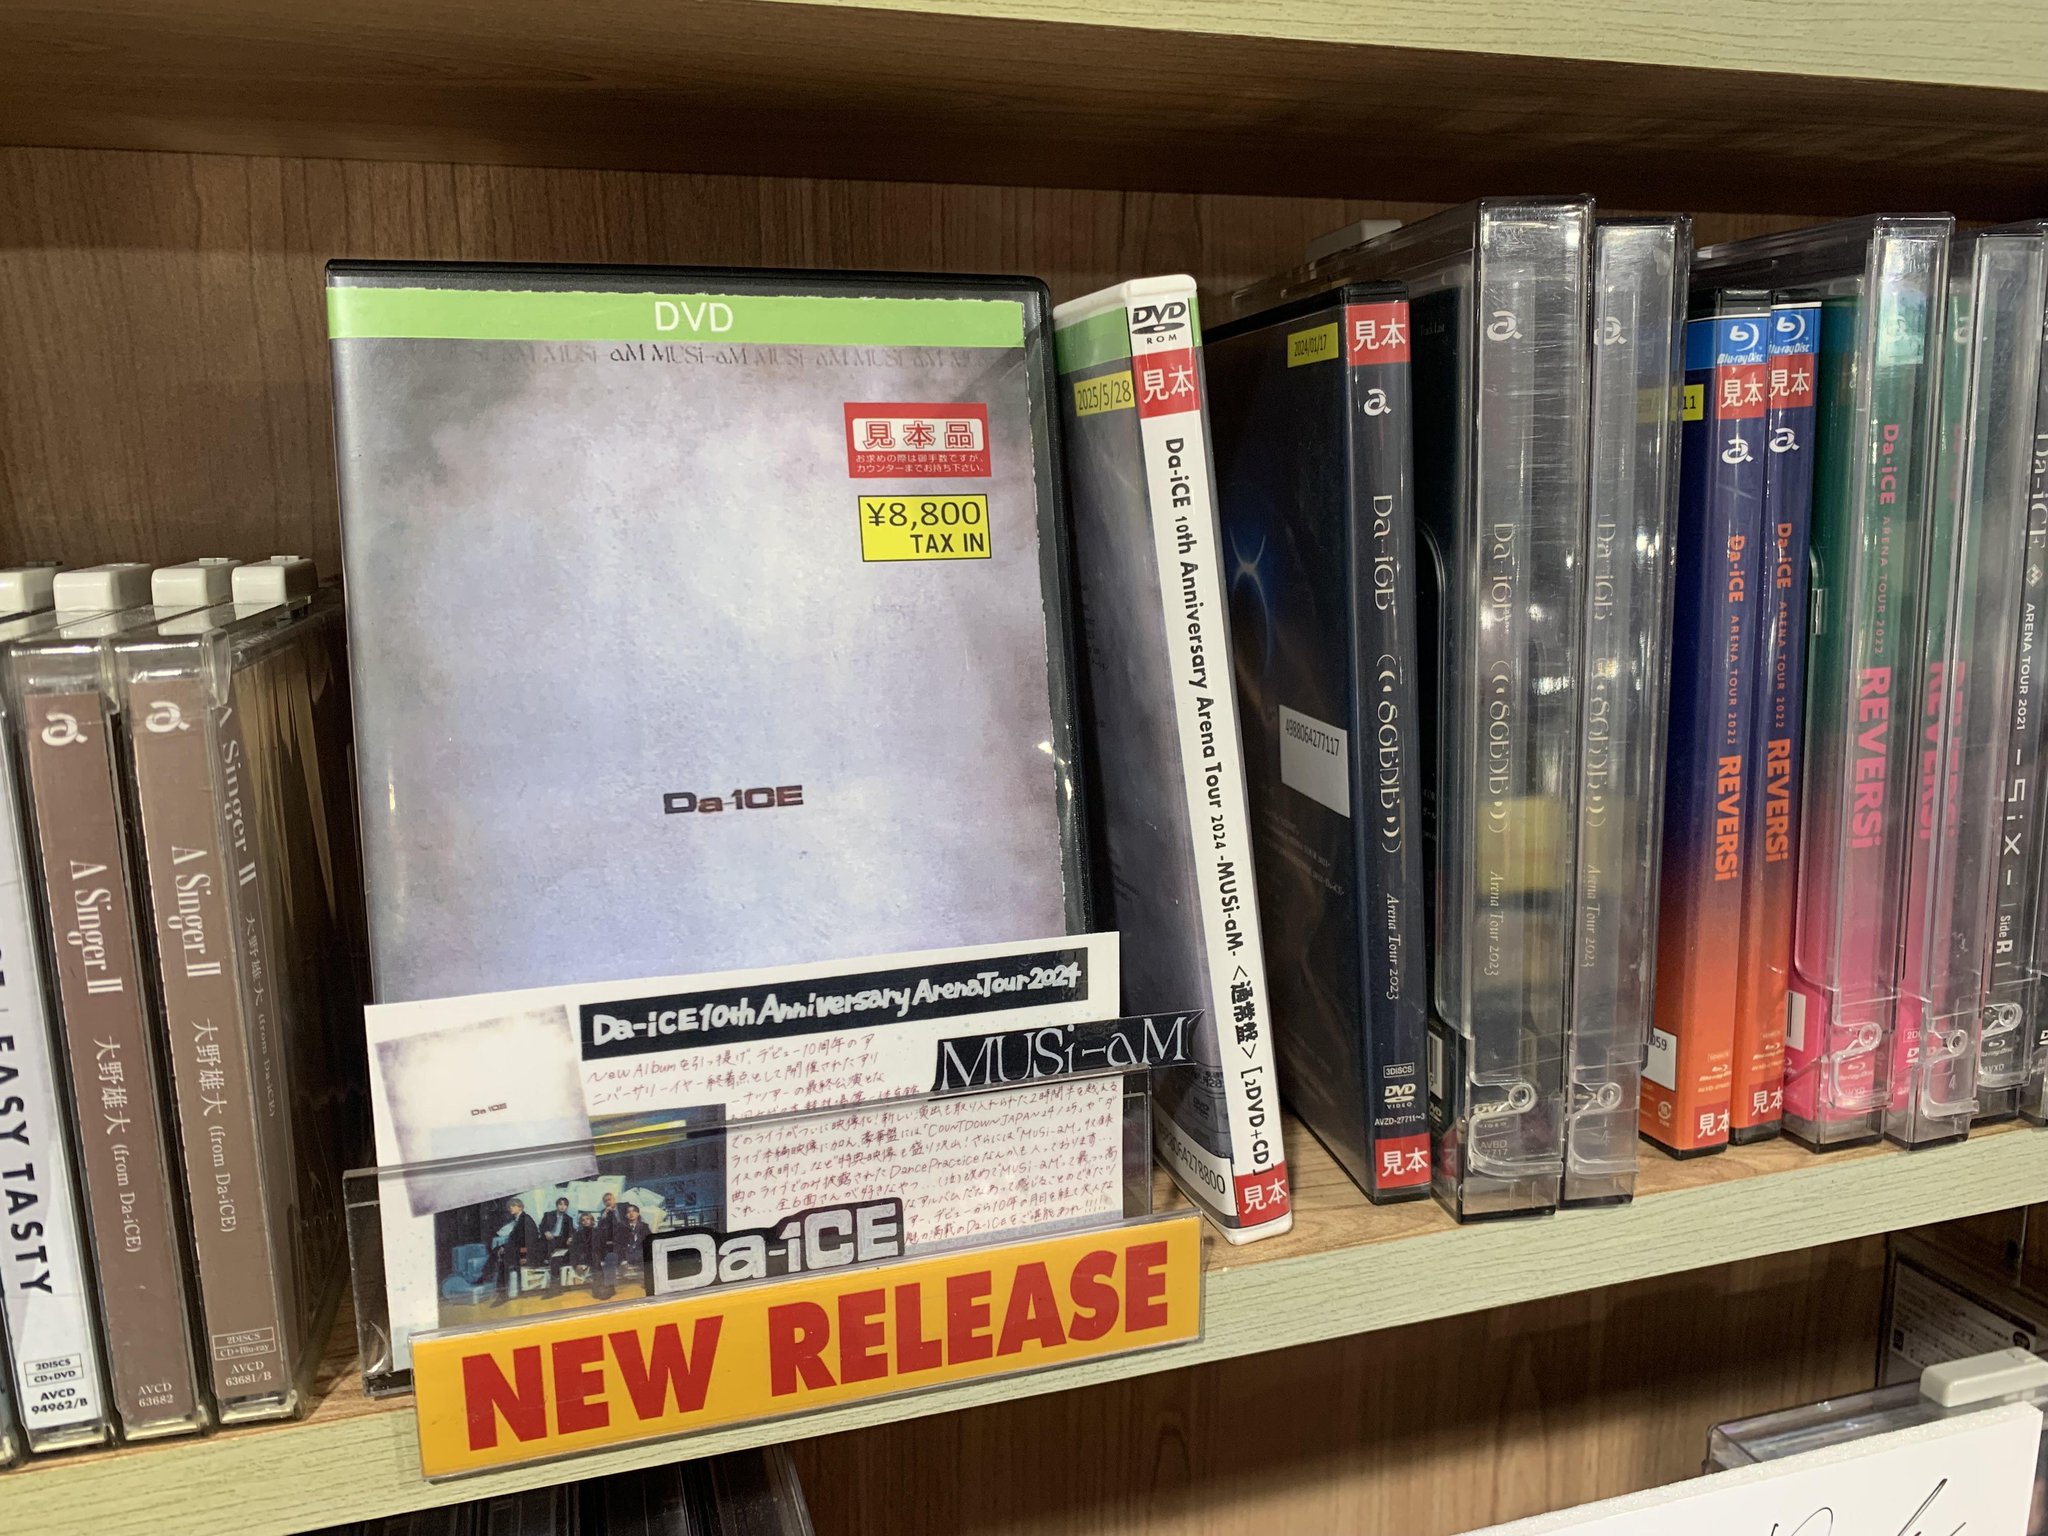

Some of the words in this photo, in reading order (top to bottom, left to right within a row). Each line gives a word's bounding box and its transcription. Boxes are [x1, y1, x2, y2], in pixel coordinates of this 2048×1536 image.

[655, 302, 734, 332] DVD
[1132, 301, 1187, 325] DVD
[1146, 334, 1178, 344] ROM
[1353, 317, 1406, 352] 見本
[1077, 380, 1132, 411] 2025/5/28
[1143, 364, 1195, 404] 見本
[1721, 376, 1764, 408] 見本
[1768, 367, 1811, 398] 見本
[863, 420, 975, 449] 見本品
[1165, 437, 1191, 508] Da-iCE
[1879, 423, 1900, 506] Da-iCE
[867, 501, 981, 531] ¥8,800
[910, 533, 955, 553] TAX
[963, 532, 985, 552] IN
[1175, 516, 1197, 555] 10th
[1879, 516, 1890, 568] ARENA
[1728, 534, 1746, 603] Da-iCE
[1776, 522, 1793, 590] Da-iCE
[1876, 574, 1888, 614] TOUR
[1180, 561, 1208, 689] Anniversary
[1729, 615, 1740, 663] ARENA
[1777, 601, 1788, 648] ARENA
[1874, 619, 1885, 655] 2022
[2022, 602, 2036, 654] ARENA
[1728, 668, 1739, 706] TOUR
[1776, 653, 1786, 690] TOUR
[2018, 655, 2032, 695] TOUR
[1196, 696, 1216, 759] Arena
[1727, 713, 1737, 745] 2022
[1775, 696, 1785, 729] 2022
[2016, 698, 2028, 731] 2021
[1852, 666, 1892, 849] REVERSi
[221, 737, 249, 852] Singer
[1205, 762, 1222, 808] Tour
[1765, 737, 1791, 863] REVERSi
[1211, 814, 1226, 850] 2024
[1715, 754, 1742, 881] REVERSi
[69, 859, 108, 880] A
[171, 844, 208, 865] A
[66, 888, 112, 973] Singer
[167, 871, 212, 963] Singer
[1489, 911, 1504, 941] Tour
[1388, 934, 1401, 965] Tour
[1484, 946, 1500, 977] 2023
[1386, 968, 1399, 1000] 2023
[93, 1034, 132, 1136] 大野雄大
[190, 1017, 224, 1119] 大野雄大
[1385, 1065, 1413, 1077] 3DISCS
[1384, 1083, 1417, 1097] DVD
[1751, 1086, 1784, 1117] 見本
[1697, 1109, 1730, 1139] 見本
[207, 1123, 226, 1170] (from
[1382, 1147, 1428, 1177] 見本
[110, 1143, 130, 1188] (from
[213, 1172, 237, 1233] Da-iCE)
[1244, 1179, 1288, 1215] 見本
[2, 1162, 54, 1295] TASTY
[118, 1191, 143, 1253] Da-iCE)
[652, 1200, 900, 1296] Da-iCE
[462, 1315, 724, 1452] NEW
[767, 1240, 1169, 1397] RELEASE
[34, 1358, 71, 1371] 2DISCS
[34, 1370, 77, 1383] CD+DVD
[225, 1371, 272, 1387] 63681/B
[230, 1360, 265, 1374] AVCD
[31, 1397, 88, 1414] 94962/B
[40, 1387, 76, 1401] AVCD
[137, 1382, 172, 1396] AVCD
[138, 1394, 174, 1408] 63682
